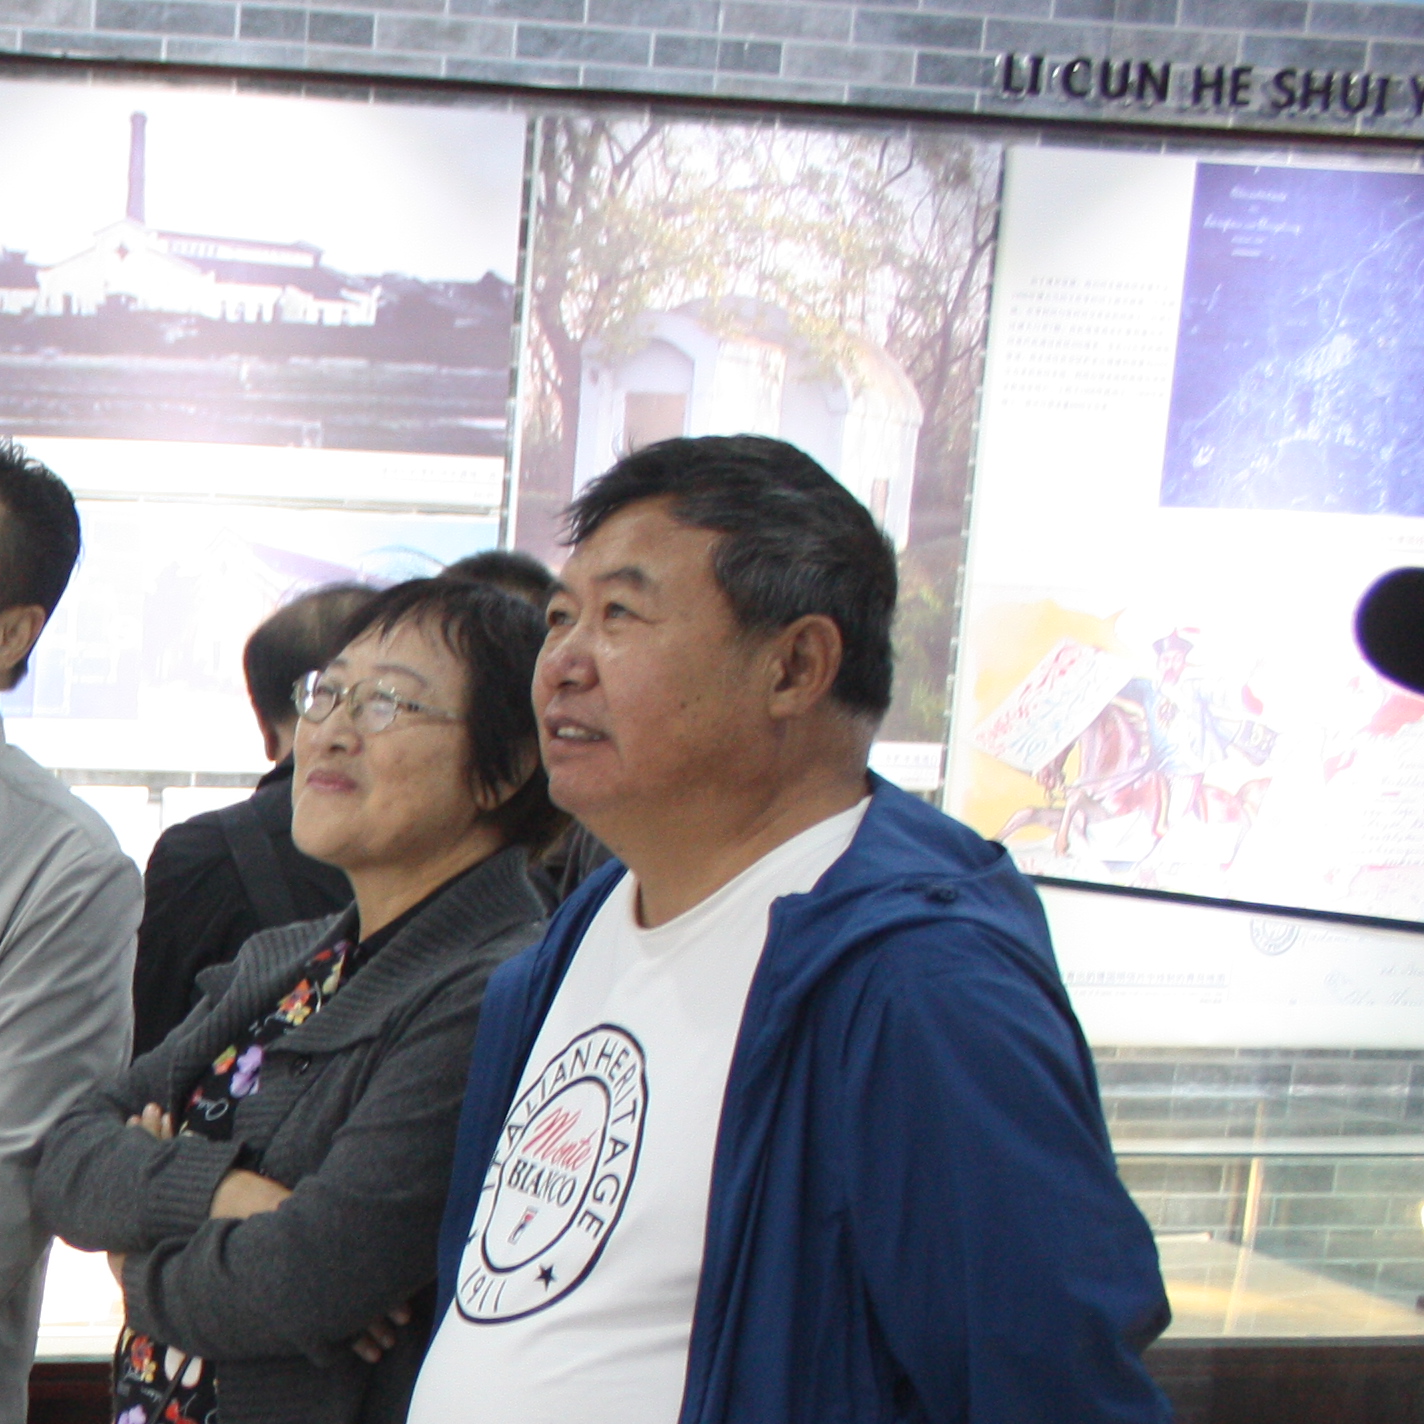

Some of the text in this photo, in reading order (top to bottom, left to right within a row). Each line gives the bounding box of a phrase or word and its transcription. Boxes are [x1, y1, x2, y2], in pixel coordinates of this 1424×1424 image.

[999, 53, 1045, 97] LI
[1056, 56, 1172, 105] CUN
[1191, 64, 1254, 109] HE
[1270, 67, 1392, 118] SHUI
[578, 1038, 637, 1240] HERITAGE
[507, 1159, 577, 1208] BIANCO
